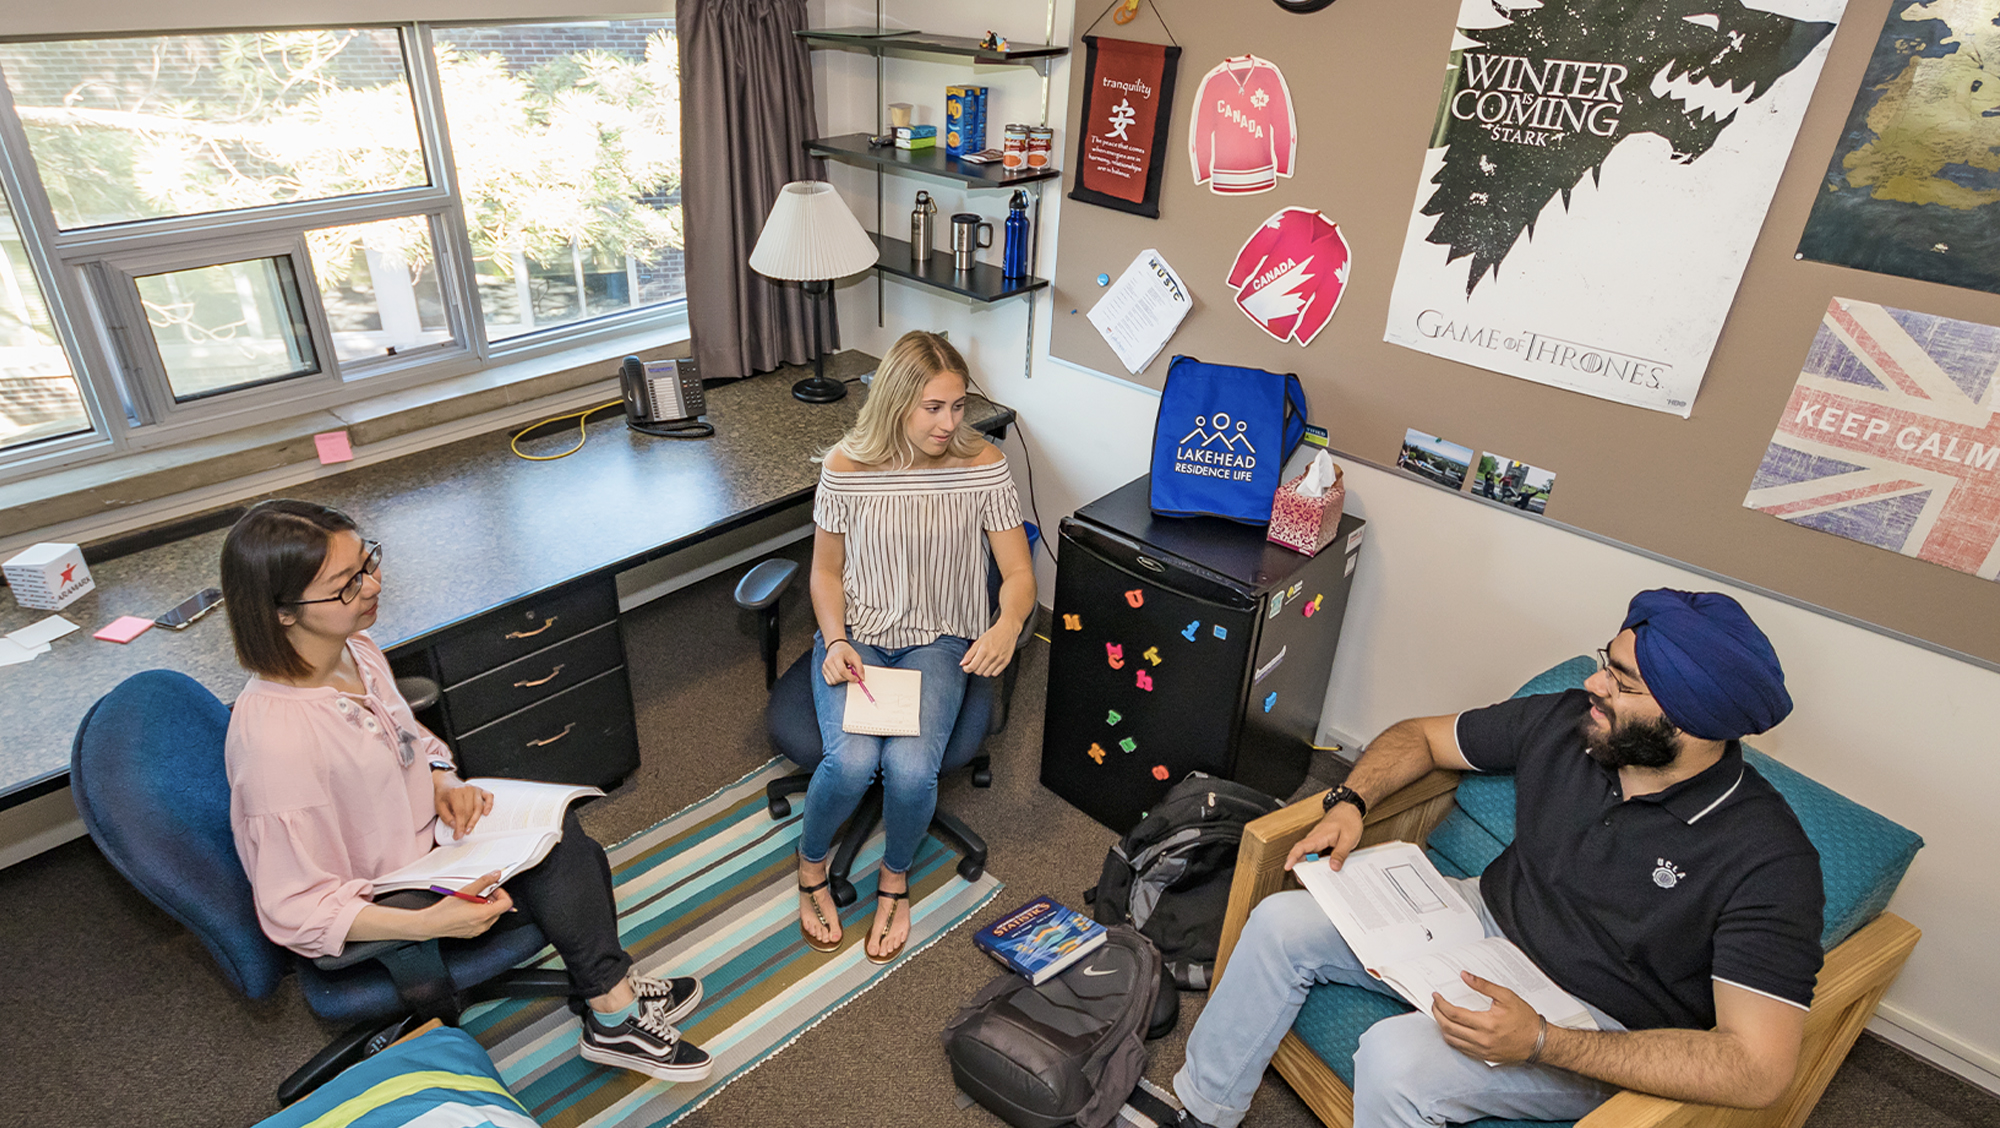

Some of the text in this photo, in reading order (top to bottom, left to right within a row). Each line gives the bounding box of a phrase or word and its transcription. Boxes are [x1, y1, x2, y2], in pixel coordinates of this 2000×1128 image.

[1103, 77, 1151, 99] tranquility
[1463, 52, 1628, 103] WINTER
[1451, 88, 1623, 137] COMING
[1521, 92, 1534, 105] IS
[1104, 98, 1136, 141] 安
[1217, 100, 1264, 139] CANADA
[1490, 124, 1549, 147] STARK
[1091, 135, 1102, 143] The
[1118, 142, 1128, 150] that
[1128, 146, 1145, 154] comes
[1148, 258, 1181, 302] MUSIC
[1252, 257, 1297, 291] CANADA
[1416, 309, 1501, 351] GAME
[1503, 337, 1526, 353] OF
[1794, 401, 2000, 471] KEEP CALM
[1174, 461, 1253, 482] RESIDENCE LIFE
[1176, 446, 1256, 469] LAKEHEAD
[58, 577, 91, 602] ARAMARK
[1657, 857, 1686, 880] UCLA
[993, 902, 1051, 937] STATISTICS
